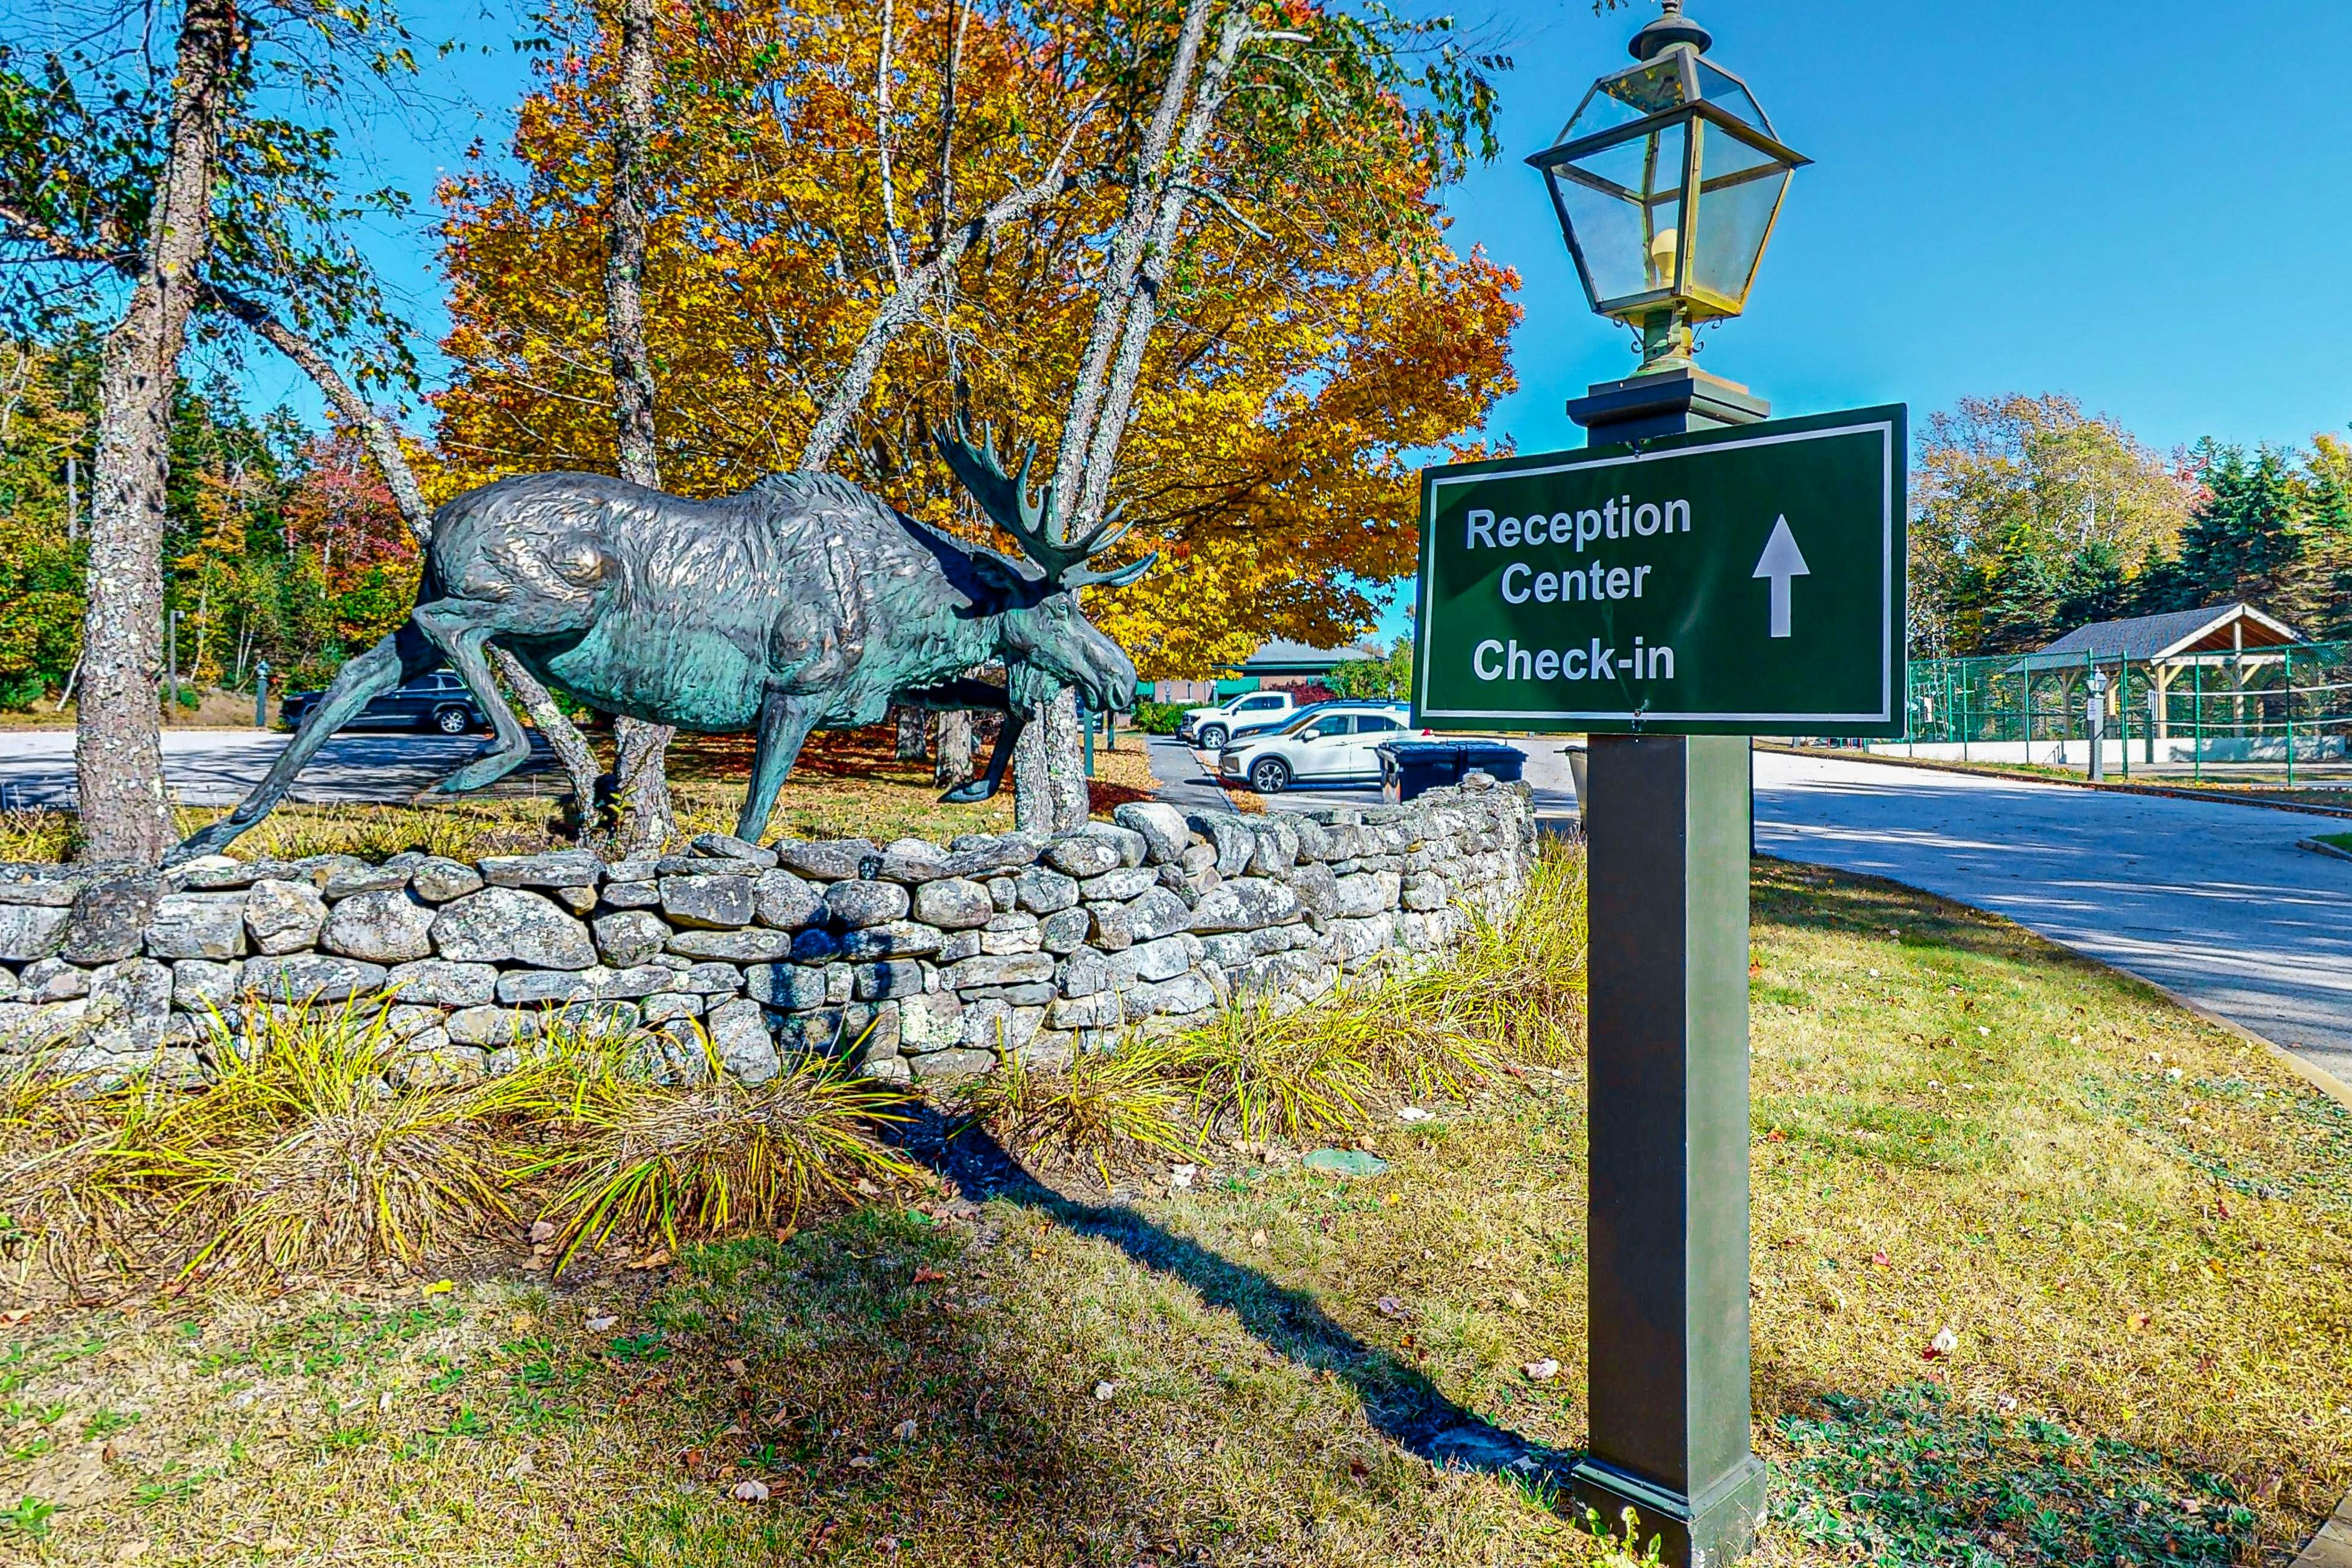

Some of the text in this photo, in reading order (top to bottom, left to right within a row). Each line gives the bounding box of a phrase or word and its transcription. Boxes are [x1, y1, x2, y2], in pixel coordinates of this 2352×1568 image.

[1467, 495, 1691, 552] Reception
[1502, 559, 1652, 604] Center
[1473, 636, 1674, 680] Check-in
